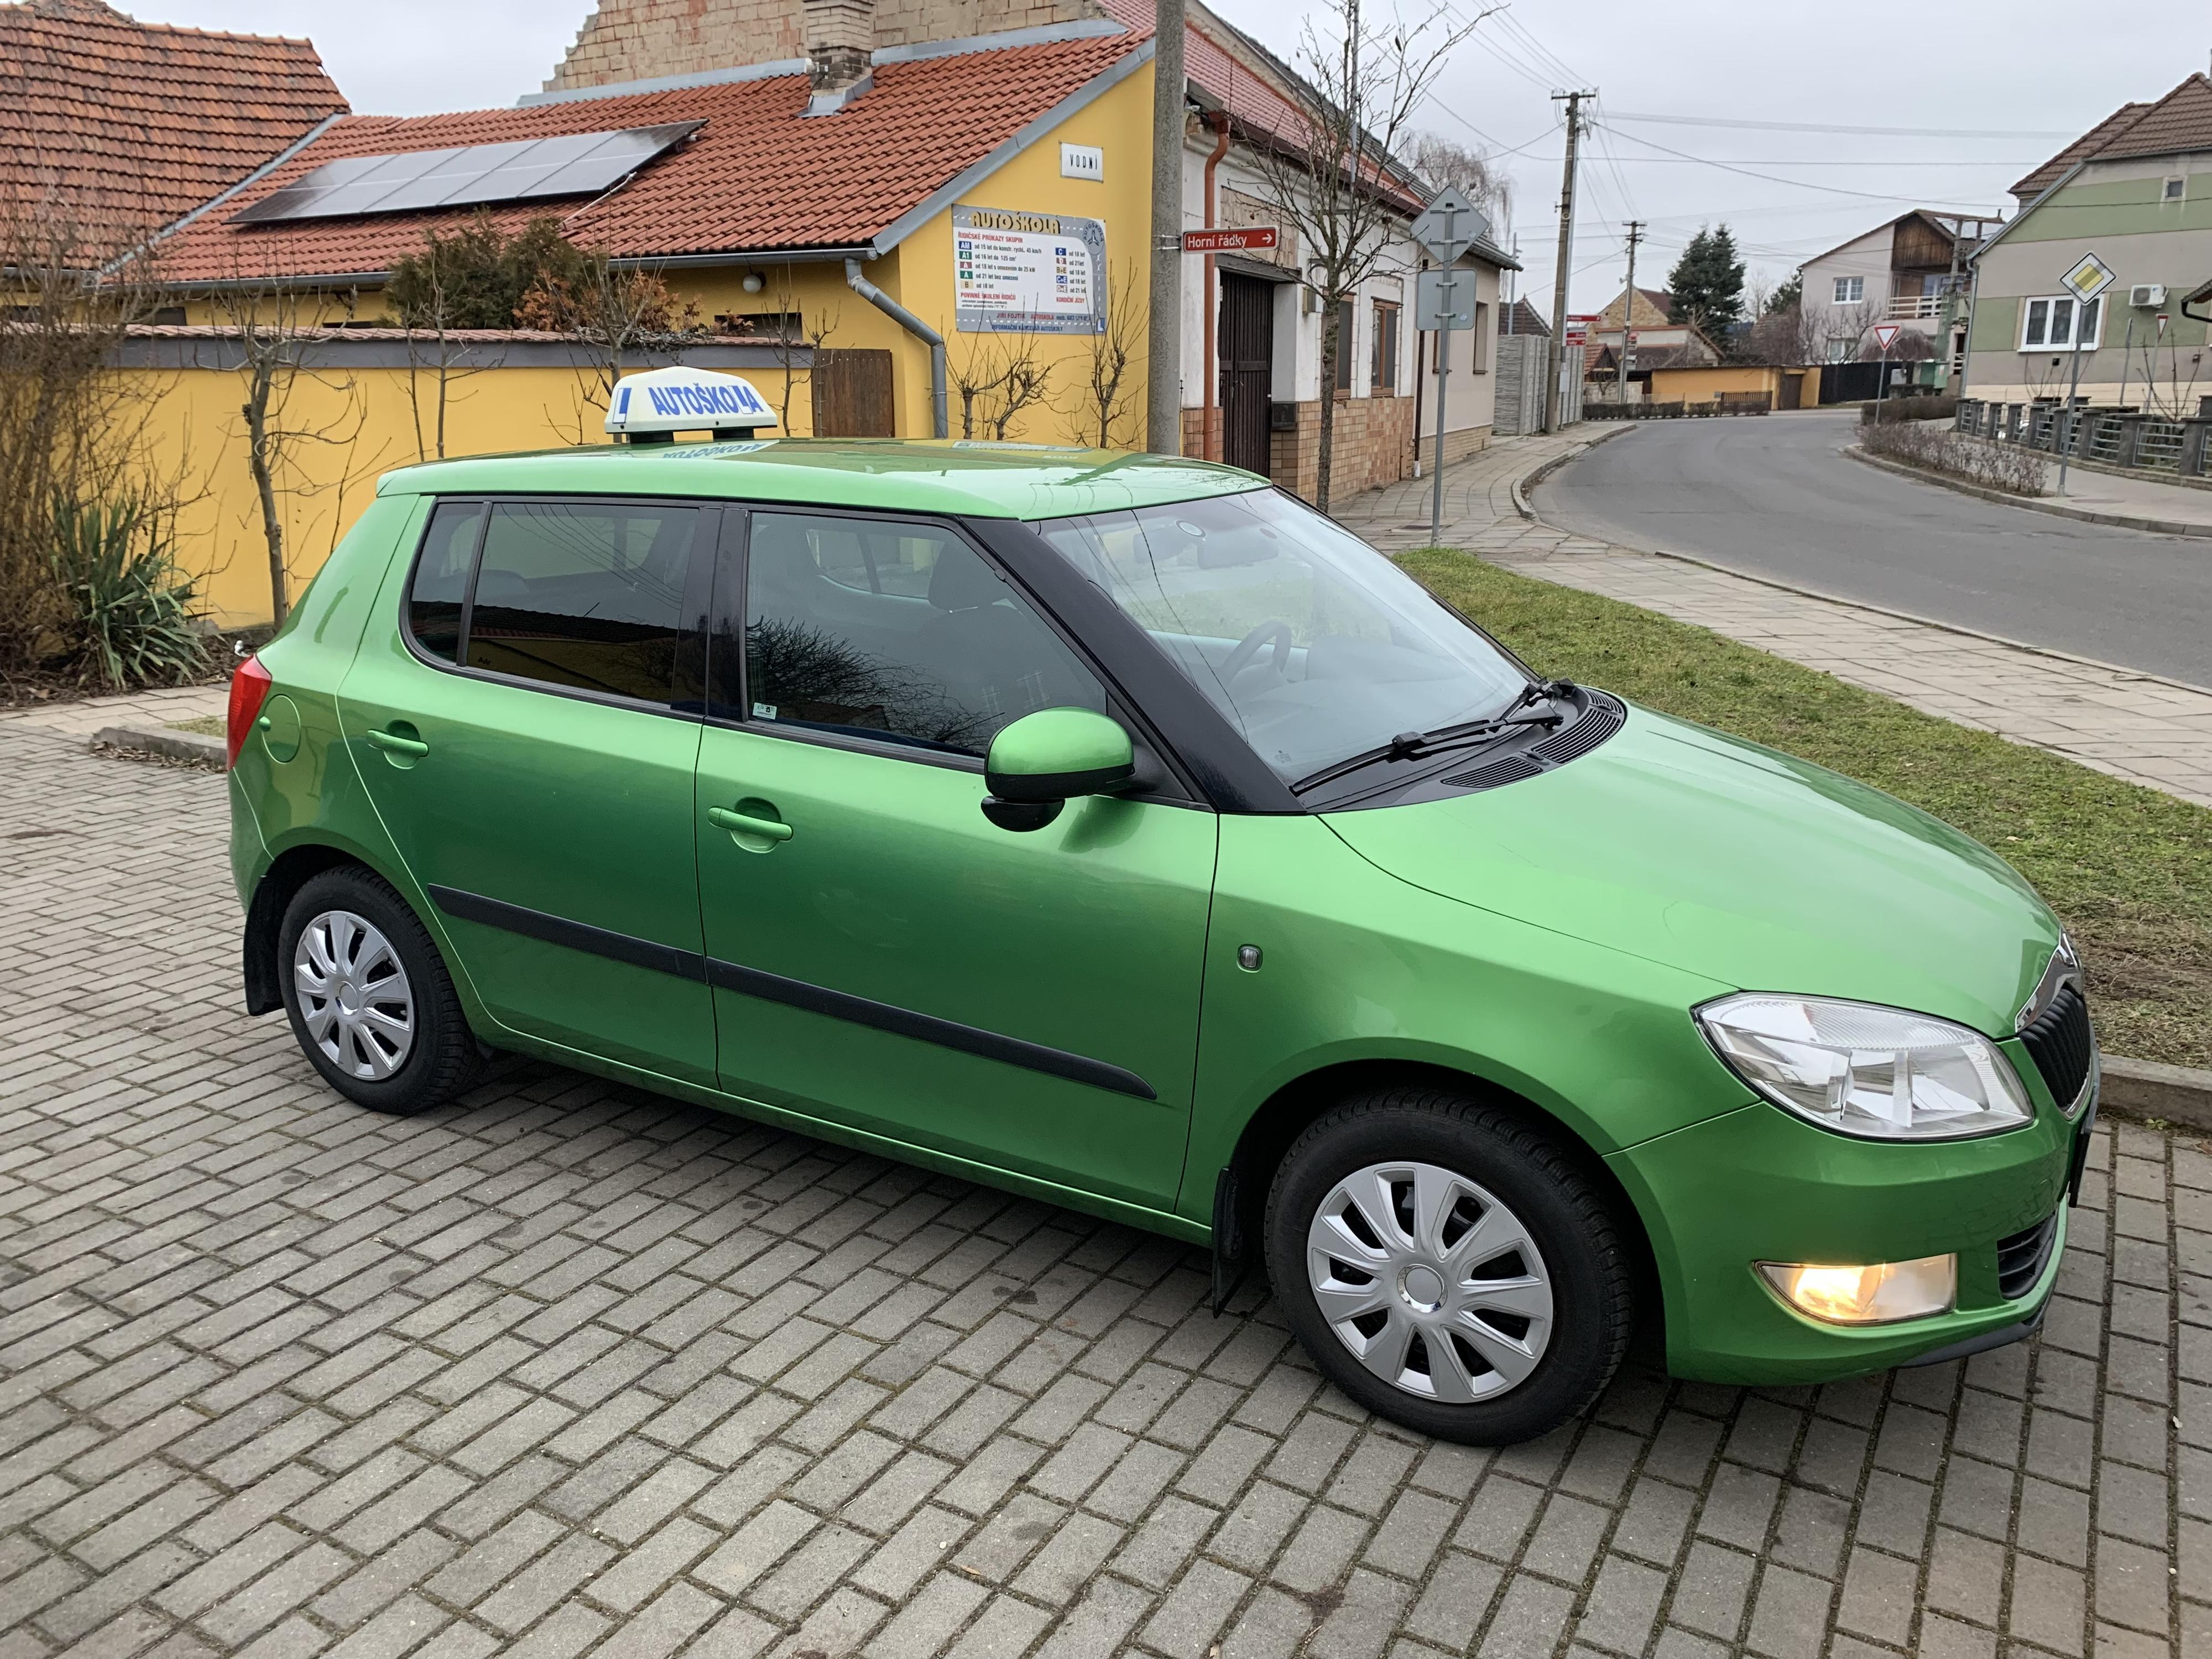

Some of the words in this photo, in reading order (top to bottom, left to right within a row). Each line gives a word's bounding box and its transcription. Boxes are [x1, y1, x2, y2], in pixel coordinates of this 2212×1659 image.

[1070, 154, 1097, 170] VODNÍ
[1188, 234, 1215, 248] Horní
[1218, 233, 1247, 248] řádky
[648, 383, 764, 416] AUTOŠKOLA
